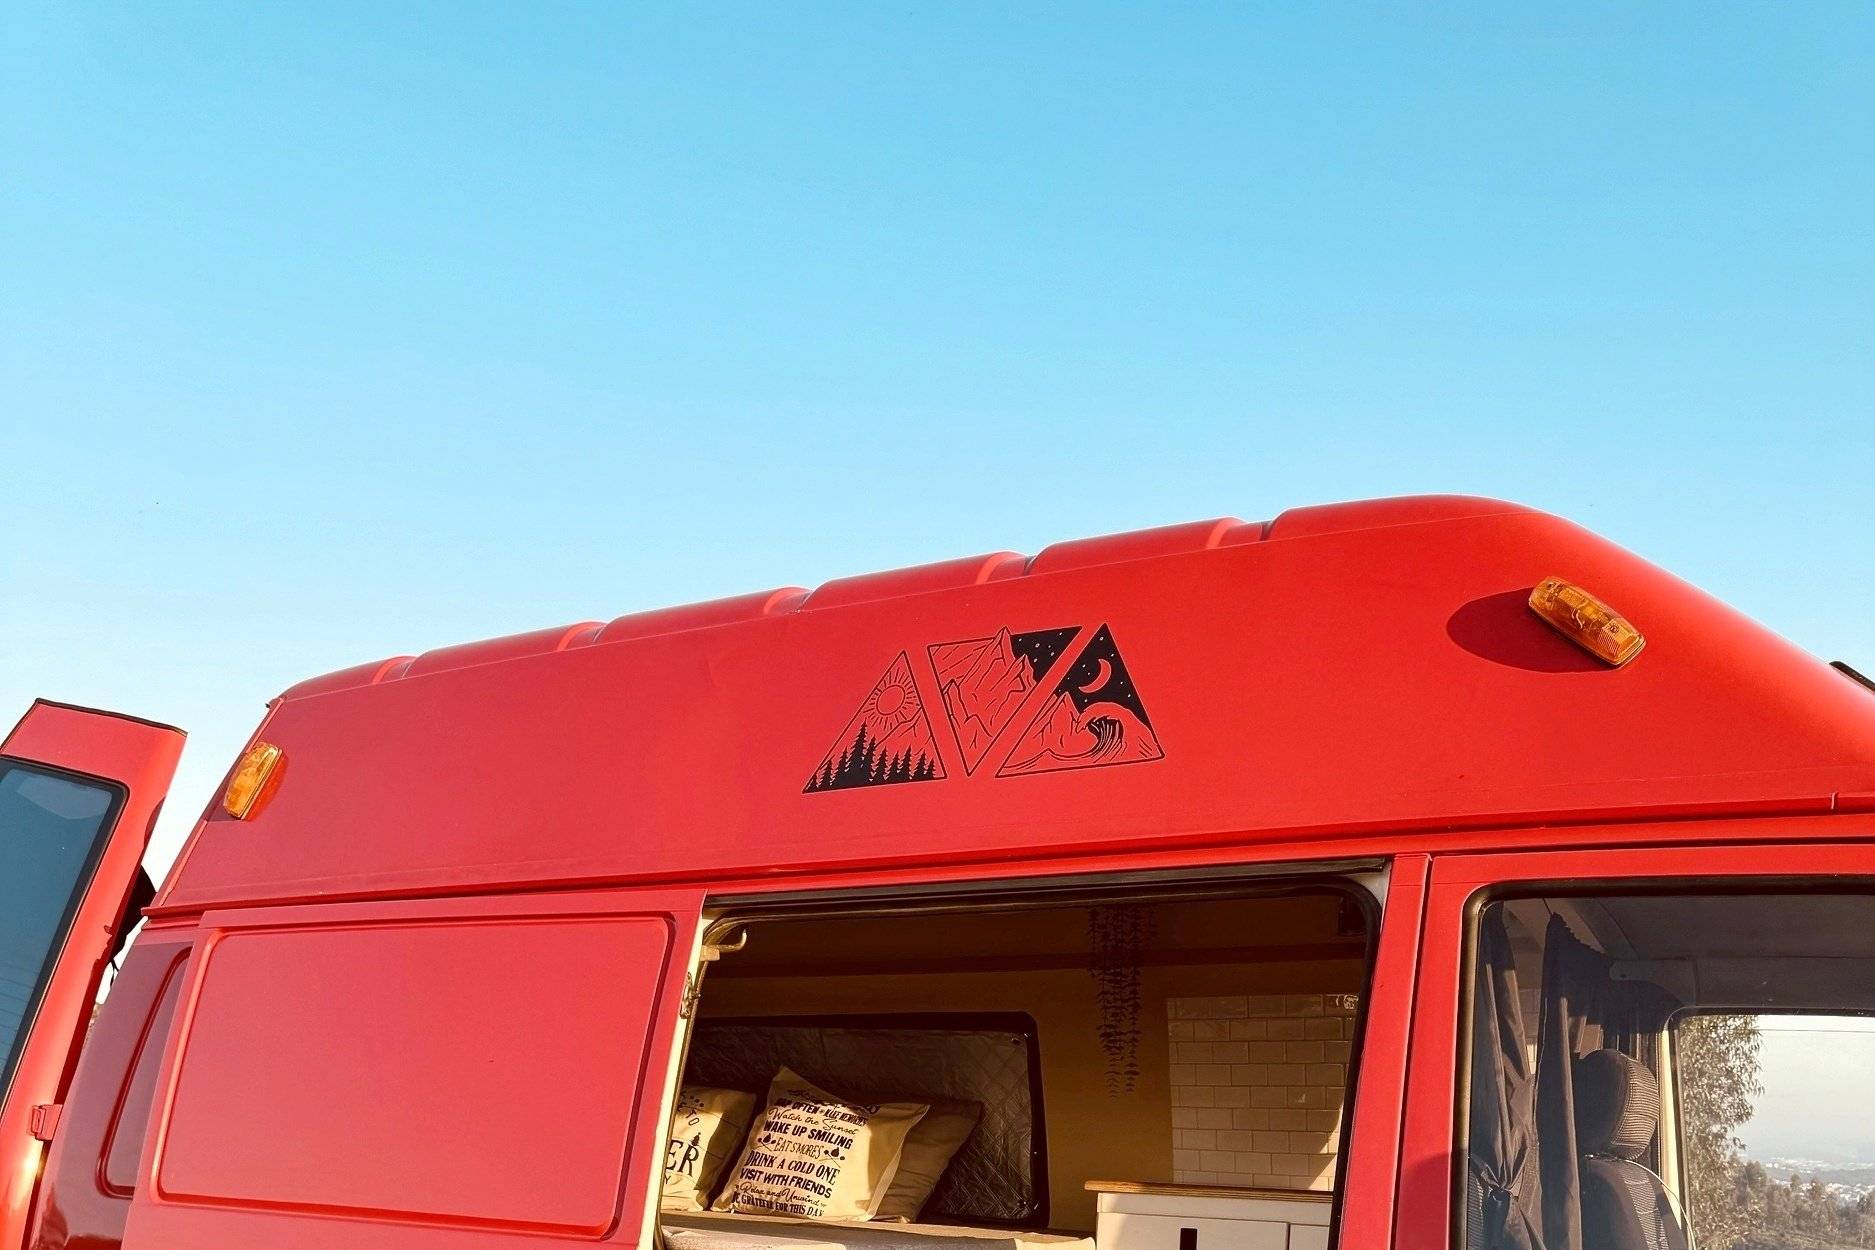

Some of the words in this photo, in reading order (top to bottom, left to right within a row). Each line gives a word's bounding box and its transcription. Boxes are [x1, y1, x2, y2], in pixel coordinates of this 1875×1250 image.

[768, 1108, 802, 1121] Watch
[804, 1116, 819, 1126] the
[822, 1118, 859, 1135] Sunset
[791, 1102, 821, 1115] OFTEN
[763, 1120, 791, 1134] WAKE
[792, 1125, 808, 1137] UP
[808, 1128, 853, 1150] SMILING
[773, 1137, 790, 1152] EAT
[744, 1150, 777, 1168] DRINK
[777, 1158, 786, 1170] A
[788, 1160, 815, 1175] COLD
[816, 1164, 840, 1186] ONE
[740, 1168, 764, 1182] VISIT
[764, 1172, 790, 1186] WITH
[788, 1175, 832, 1199] FRIENDS
[740, 1181, 765, 1196] Relax
[767, 1188, 783, 1198] and
[781, 1188, 820, 1206] Unwind
[775, 1200, 790, 1212] FOR
[790, 1203, 807, 1215] THIS
